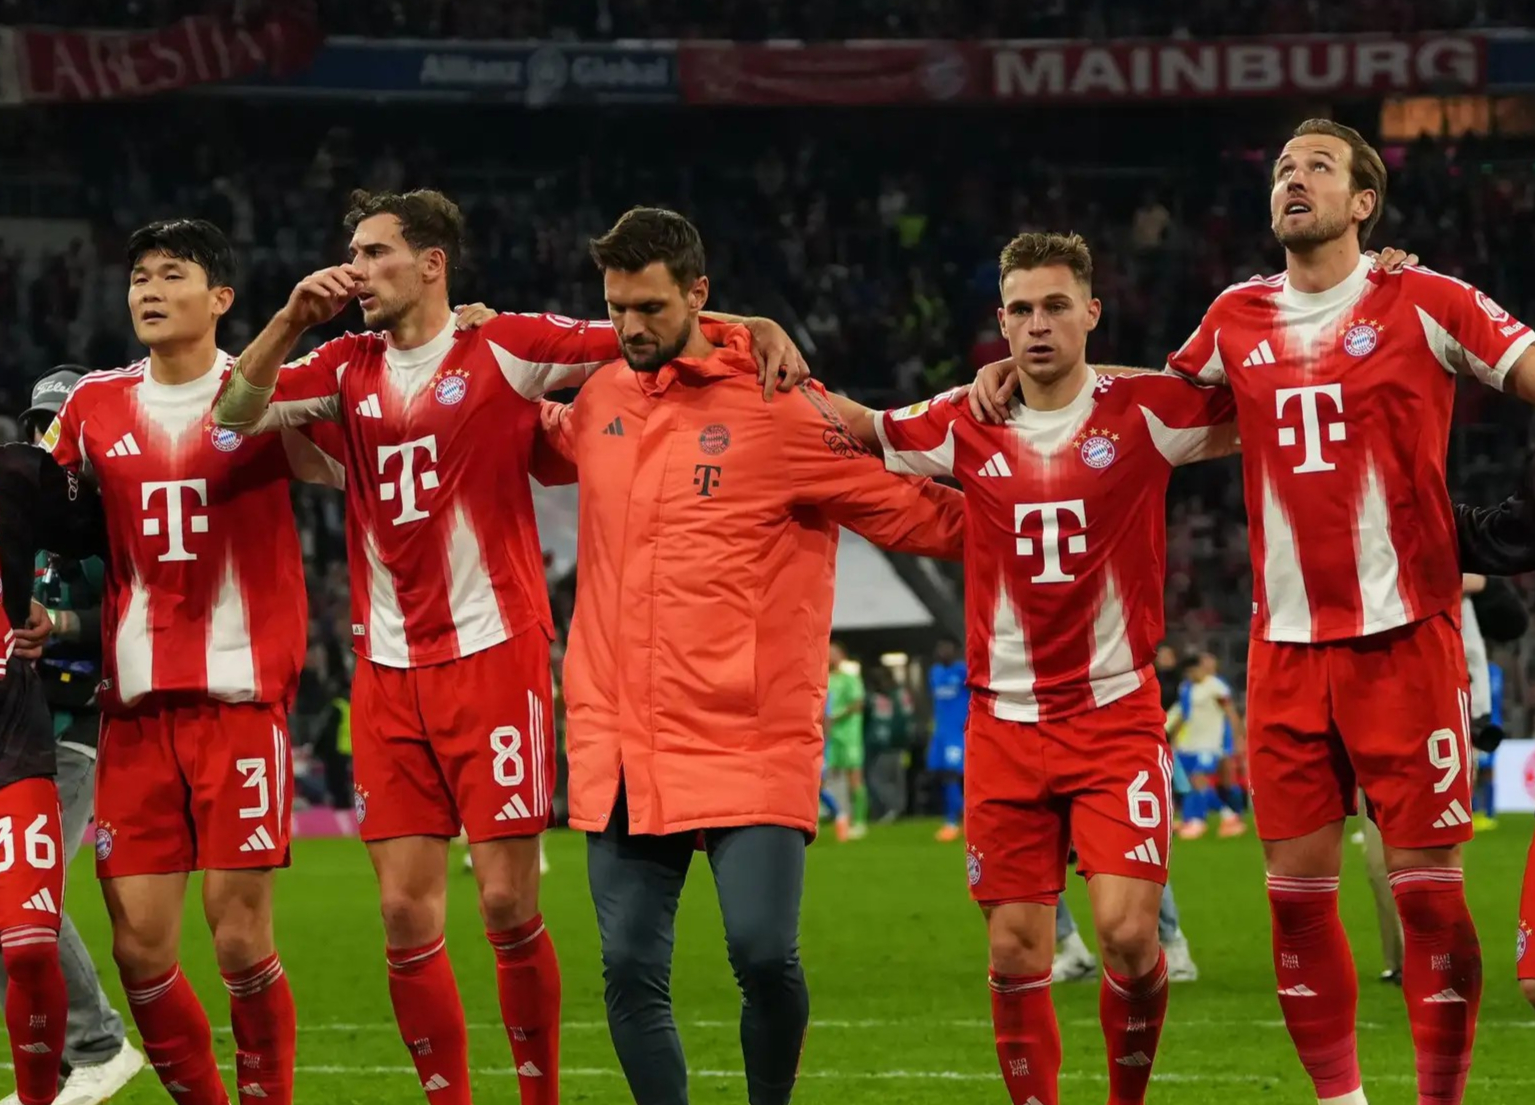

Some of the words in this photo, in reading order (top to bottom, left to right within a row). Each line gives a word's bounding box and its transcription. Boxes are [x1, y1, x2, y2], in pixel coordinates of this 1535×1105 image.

[572, 56, 668, 85] Global
[993, 39, 1477, 95] MAINBURG
[1276, 384, 1346, 473] T
[378, 435, 439, 525] T
[693, 464, 721, 497] T
[142, 479, 208, 561] T
[1015, 499, 1086, 583] T
[490, 726, 524, 786] 8
[1428, 728, 1460, 793] 9
[237, 758, 269, 818] 3
[1127, 771, 1161, 828] 6
